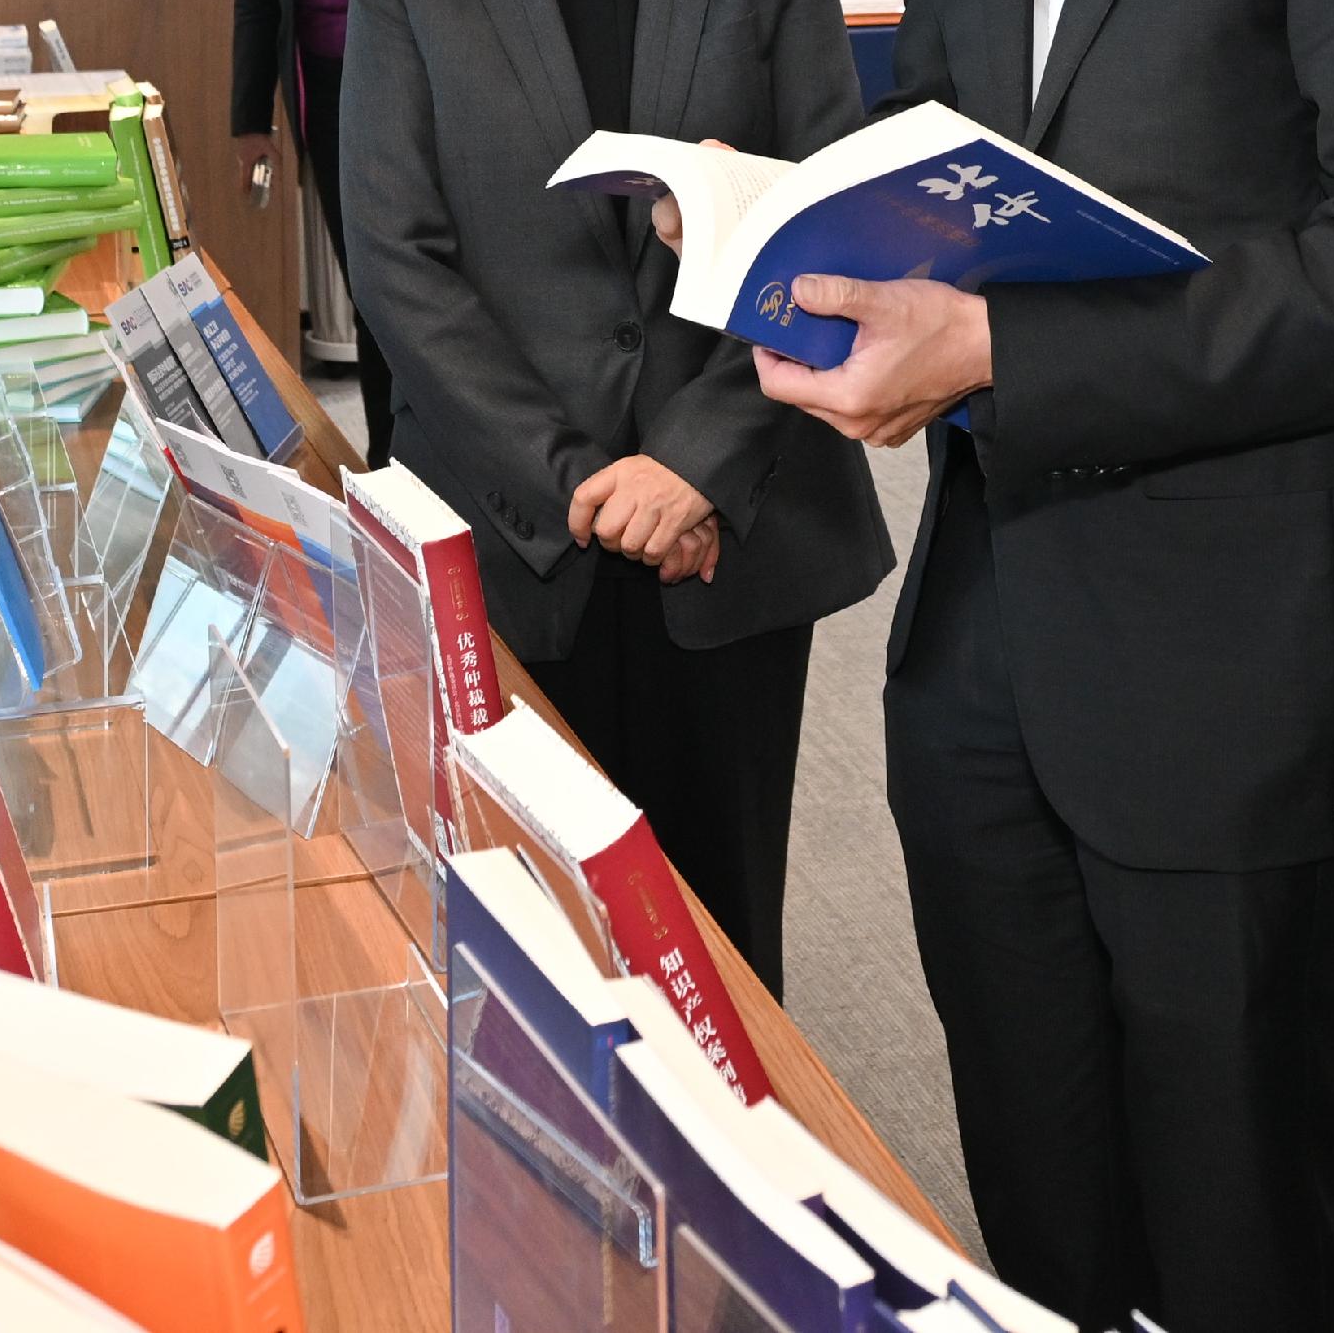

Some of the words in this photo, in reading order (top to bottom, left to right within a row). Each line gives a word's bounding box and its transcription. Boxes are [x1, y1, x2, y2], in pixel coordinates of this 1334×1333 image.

[779, 294, 796, 327] BA
[456, 632, 490, 735] 优秀仲裁裁
